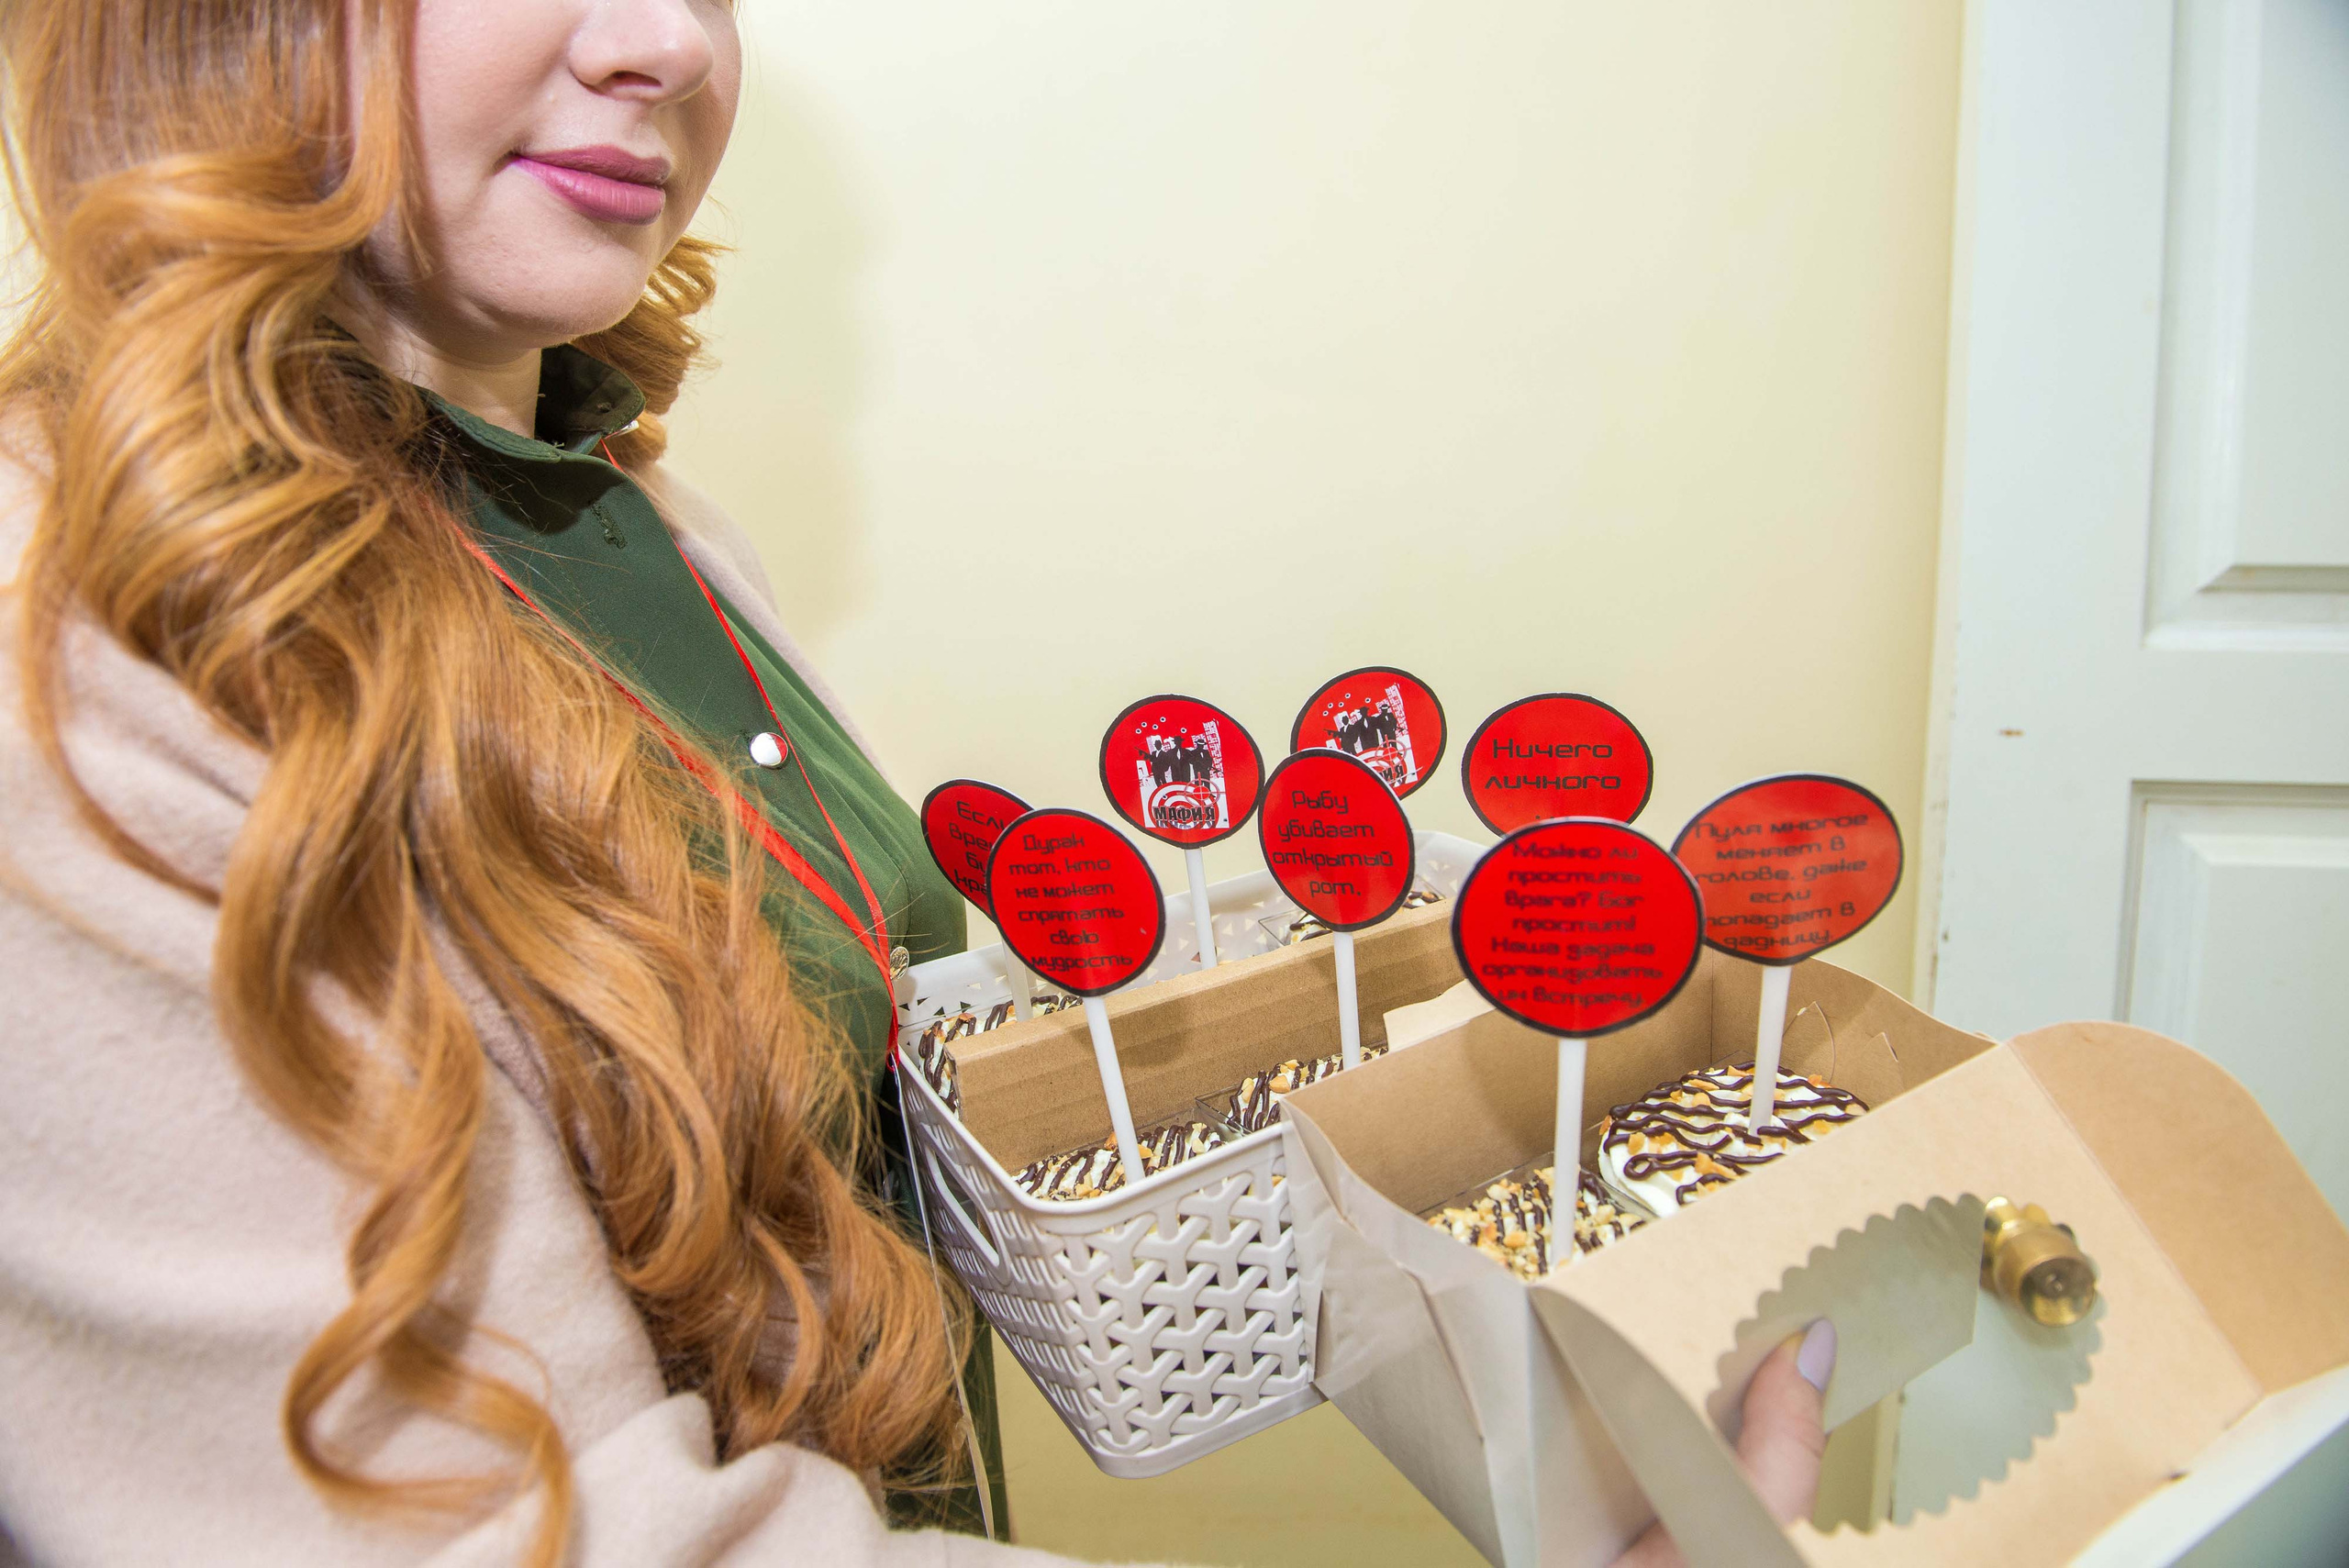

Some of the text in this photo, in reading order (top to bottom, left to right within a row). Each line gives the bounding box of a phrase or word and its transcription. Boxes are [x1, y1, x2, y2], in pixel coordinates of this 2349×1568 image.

[1493, 738, 1613, 759] Ничего
[1485, 775, 1621, 790] личного
[1292, 790, 1349, 815] Рыбу
[1153, 806, 1216, 822] МАФИЯ
[949, 822, 993, 851] вре
[1277, 819, 1375, 843] убивает
[1695, 815, 1868, 842] Пуля многое
[1023, 832, 1085, 854] Дурак
[1512, 841, 1638, 860] Можно ли
[1716, 842, 1821, 861] меняет
[1009, 858, 1111, 875] тот, кто
[1273, 848, 1393, 871] открытый
[1508, 870, 1642, 886] простить
[1803, 858, 1867, 882] даже
[1015, 883, 1115, 898] не может
[1309, 880, 1362, 897] рот.
[1749, 889, 1811, 904] если
[1504, 890, 1644, 910] врага? Бог
[1019, 907, 1124, 925] спрятать
[1050, 929, 1099, 945] свою
[1491, 937, 1560, 954] Наша
[1031, 954, 1132, 972] мудрость
